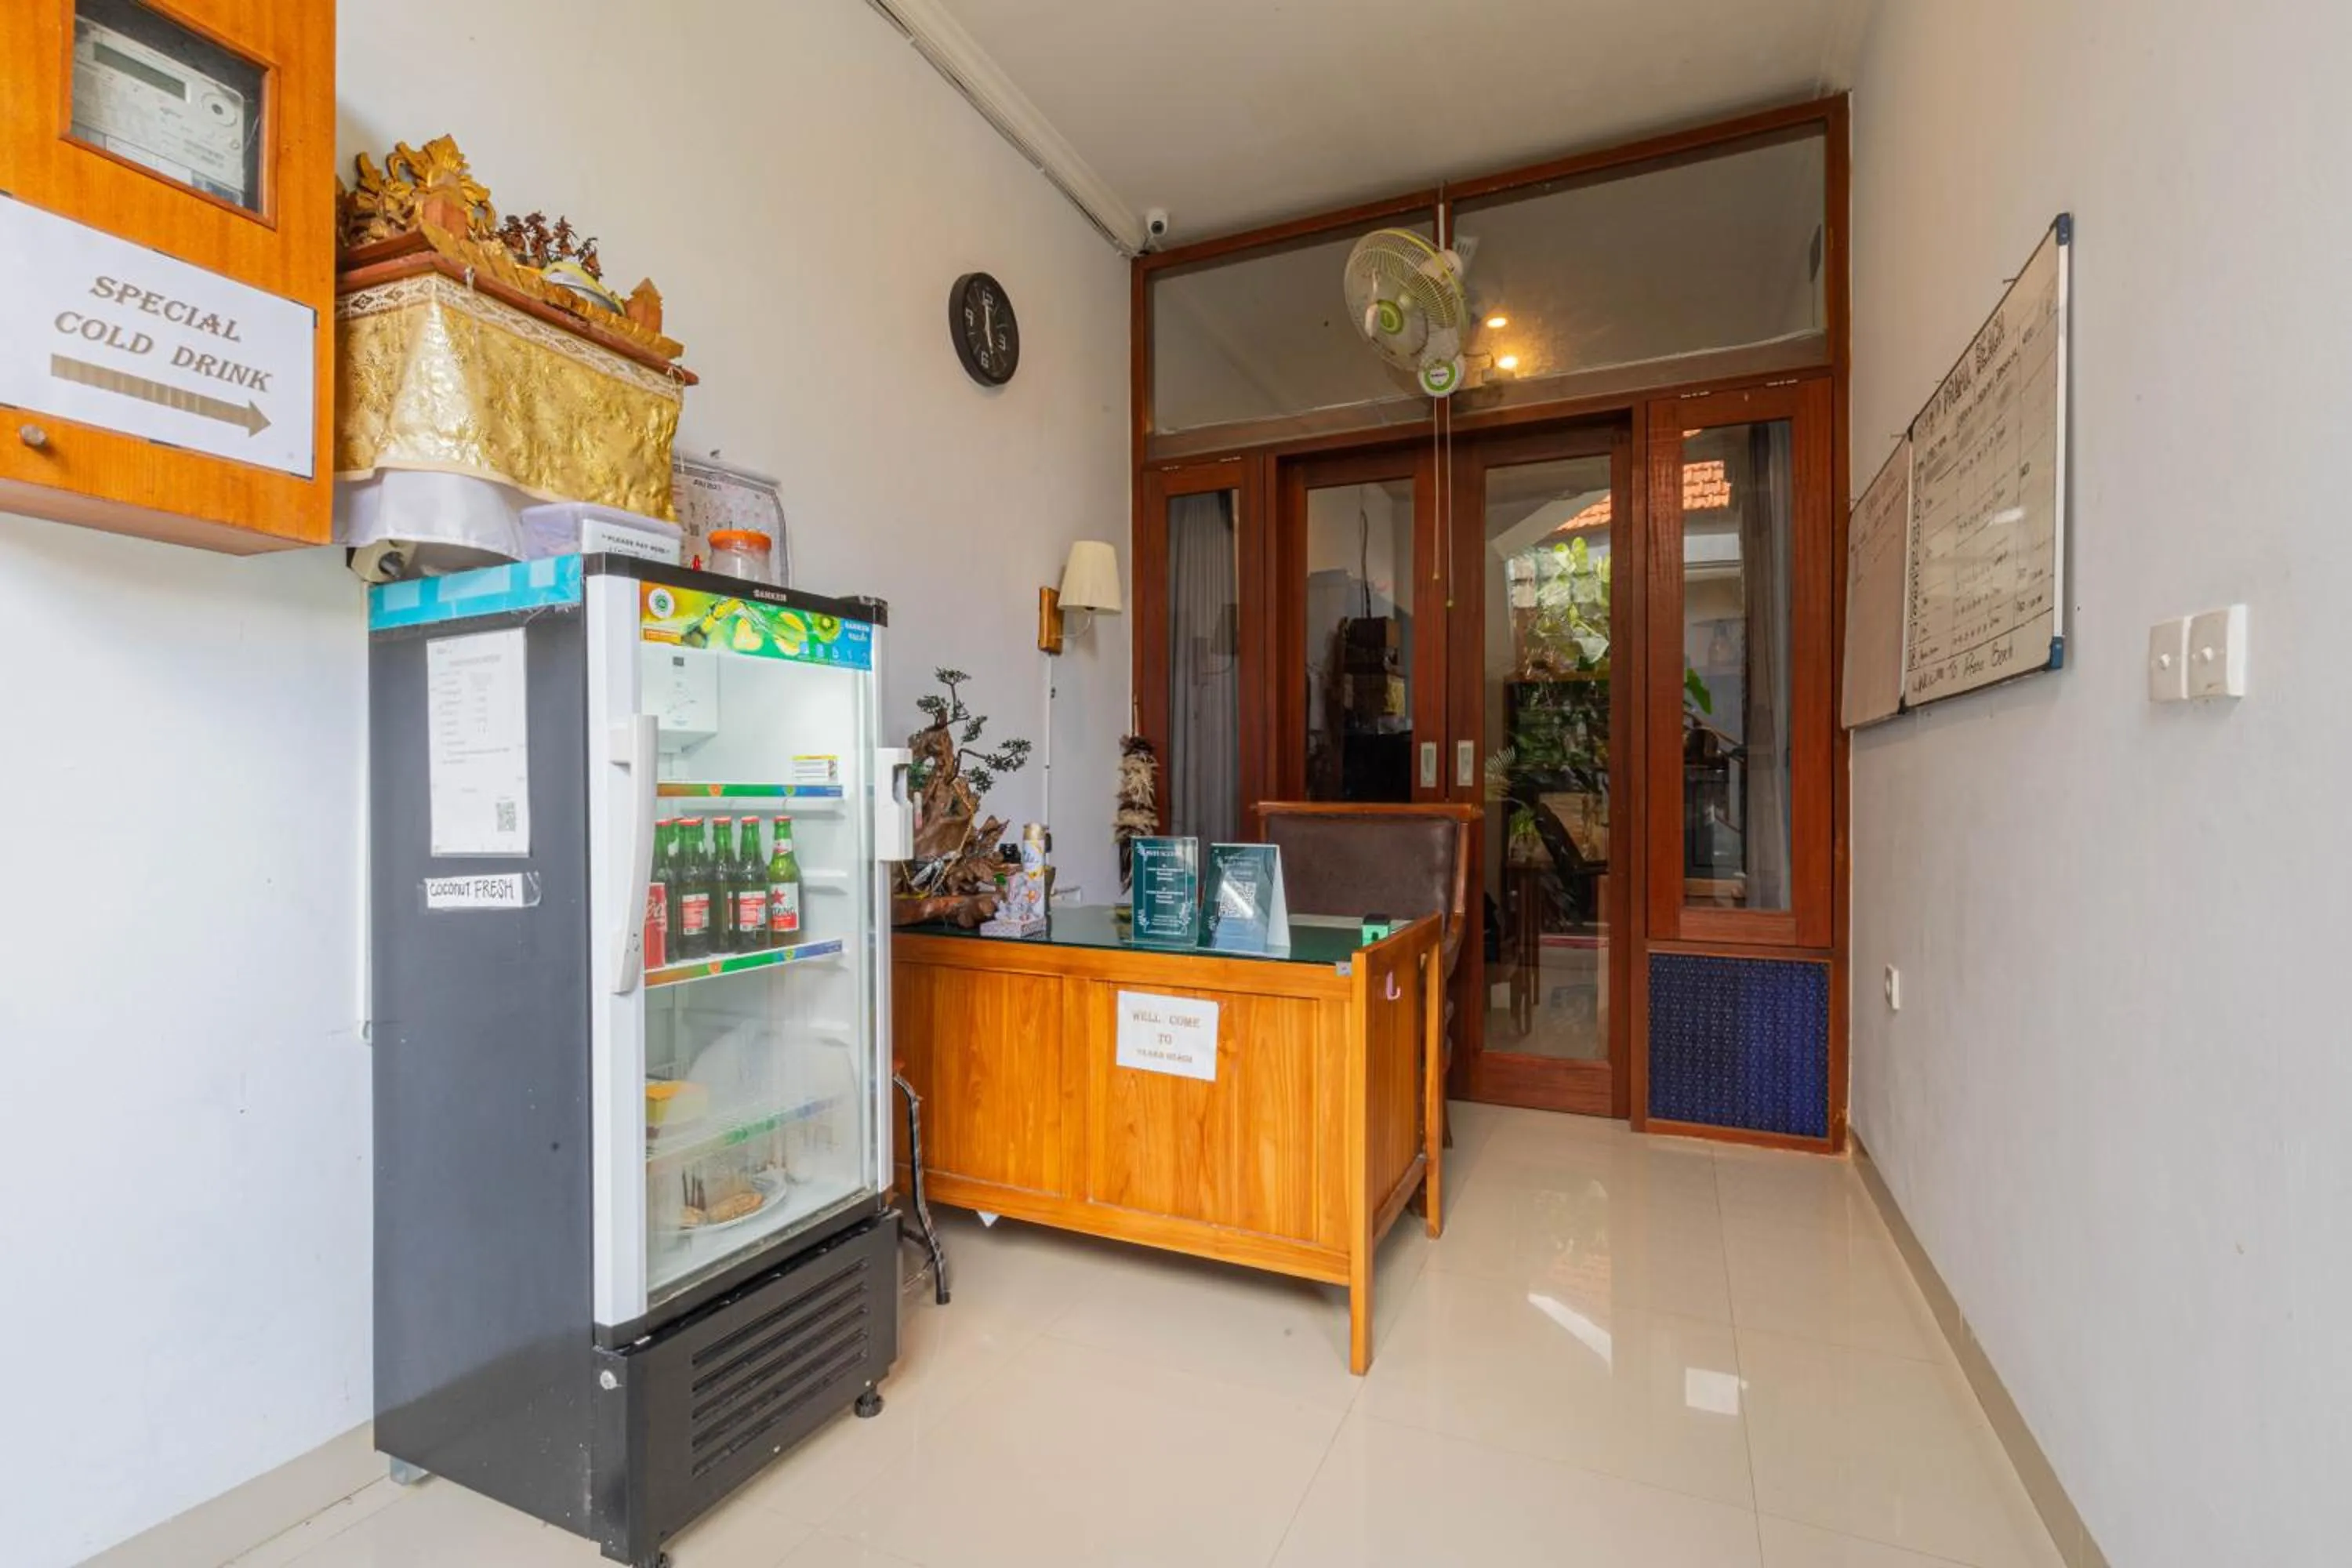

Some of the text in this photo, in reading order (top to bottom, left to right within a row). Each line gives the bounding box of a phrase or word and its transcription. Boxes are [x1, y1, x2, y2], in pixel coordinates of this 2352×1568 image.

[89, 275, 241, 343] SPECIAL
[965, 307, 975, 327] 9
[54, 310, 272, 392] COLD DRINK
[474, 878, 514, 900] FRESH
[1158, 1033, 1173, 1045] TO
